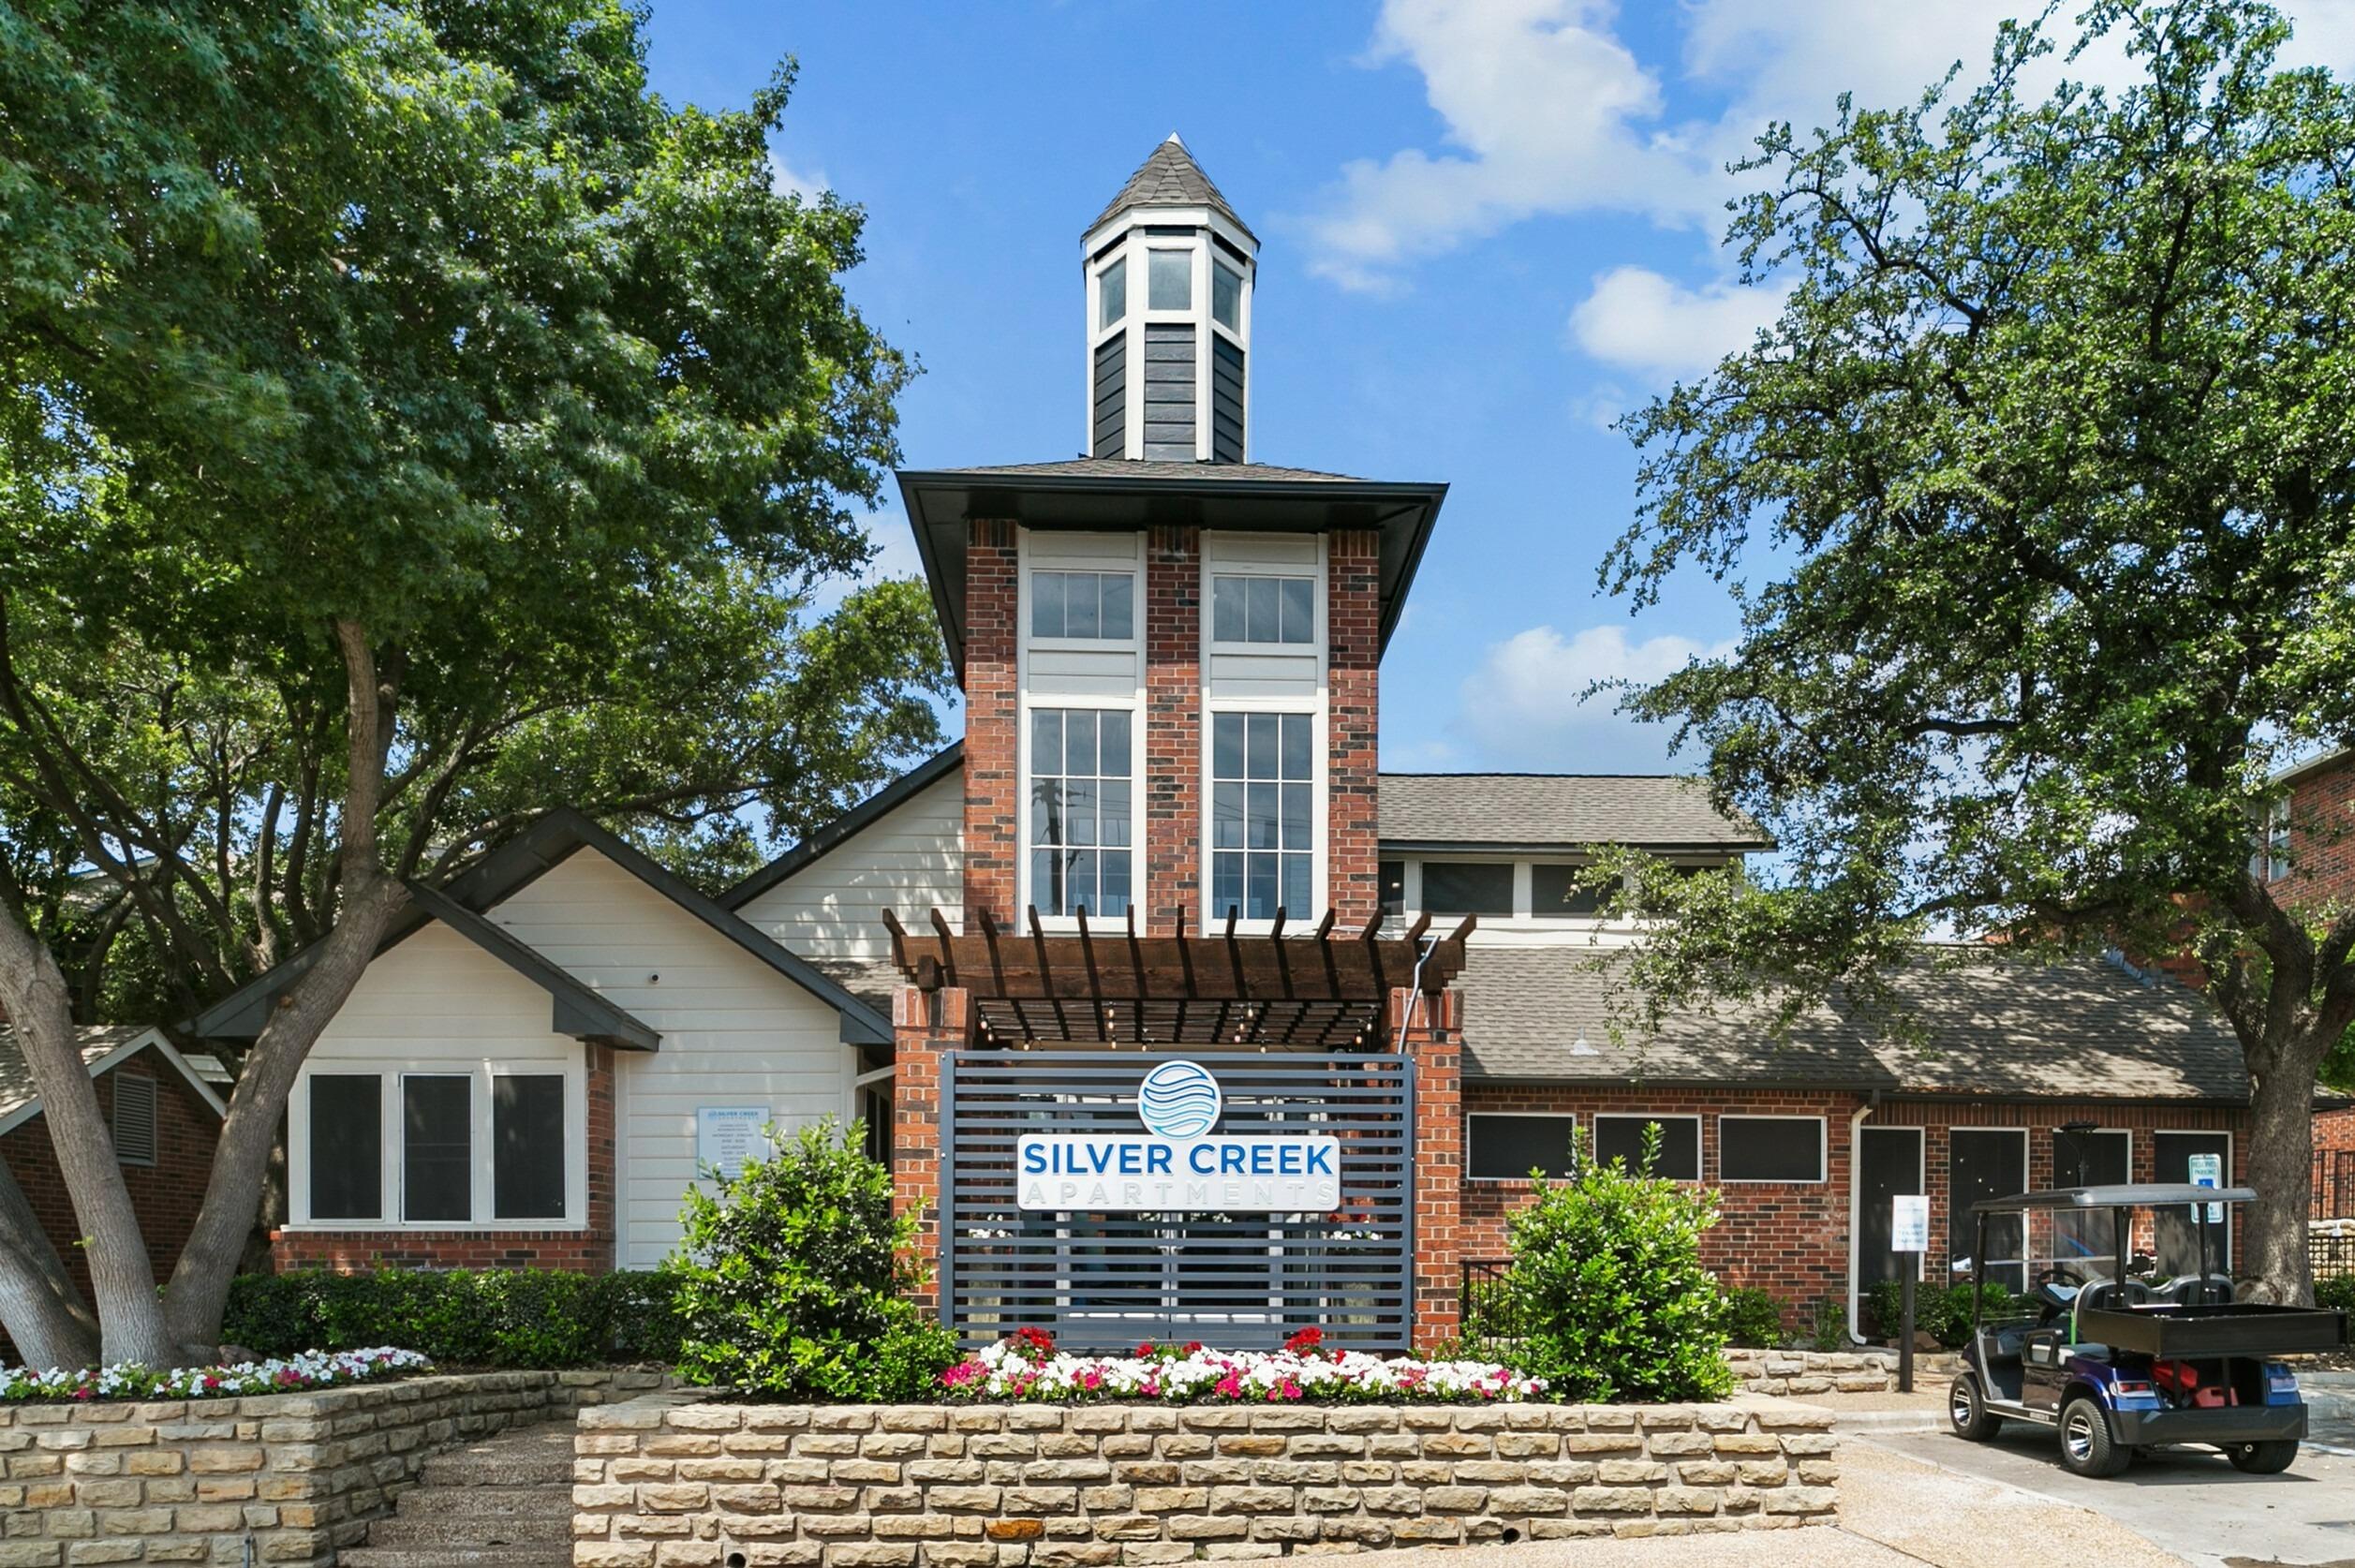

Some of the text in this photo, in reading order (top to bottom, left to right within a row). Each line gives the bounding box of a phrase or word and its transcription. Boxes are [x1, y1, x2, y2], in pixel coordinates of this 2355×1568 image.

[1024, 1143, 1333, 1175] SILVER CREEK
[1024, 1181, 1335, 1206] APARTMENTS
